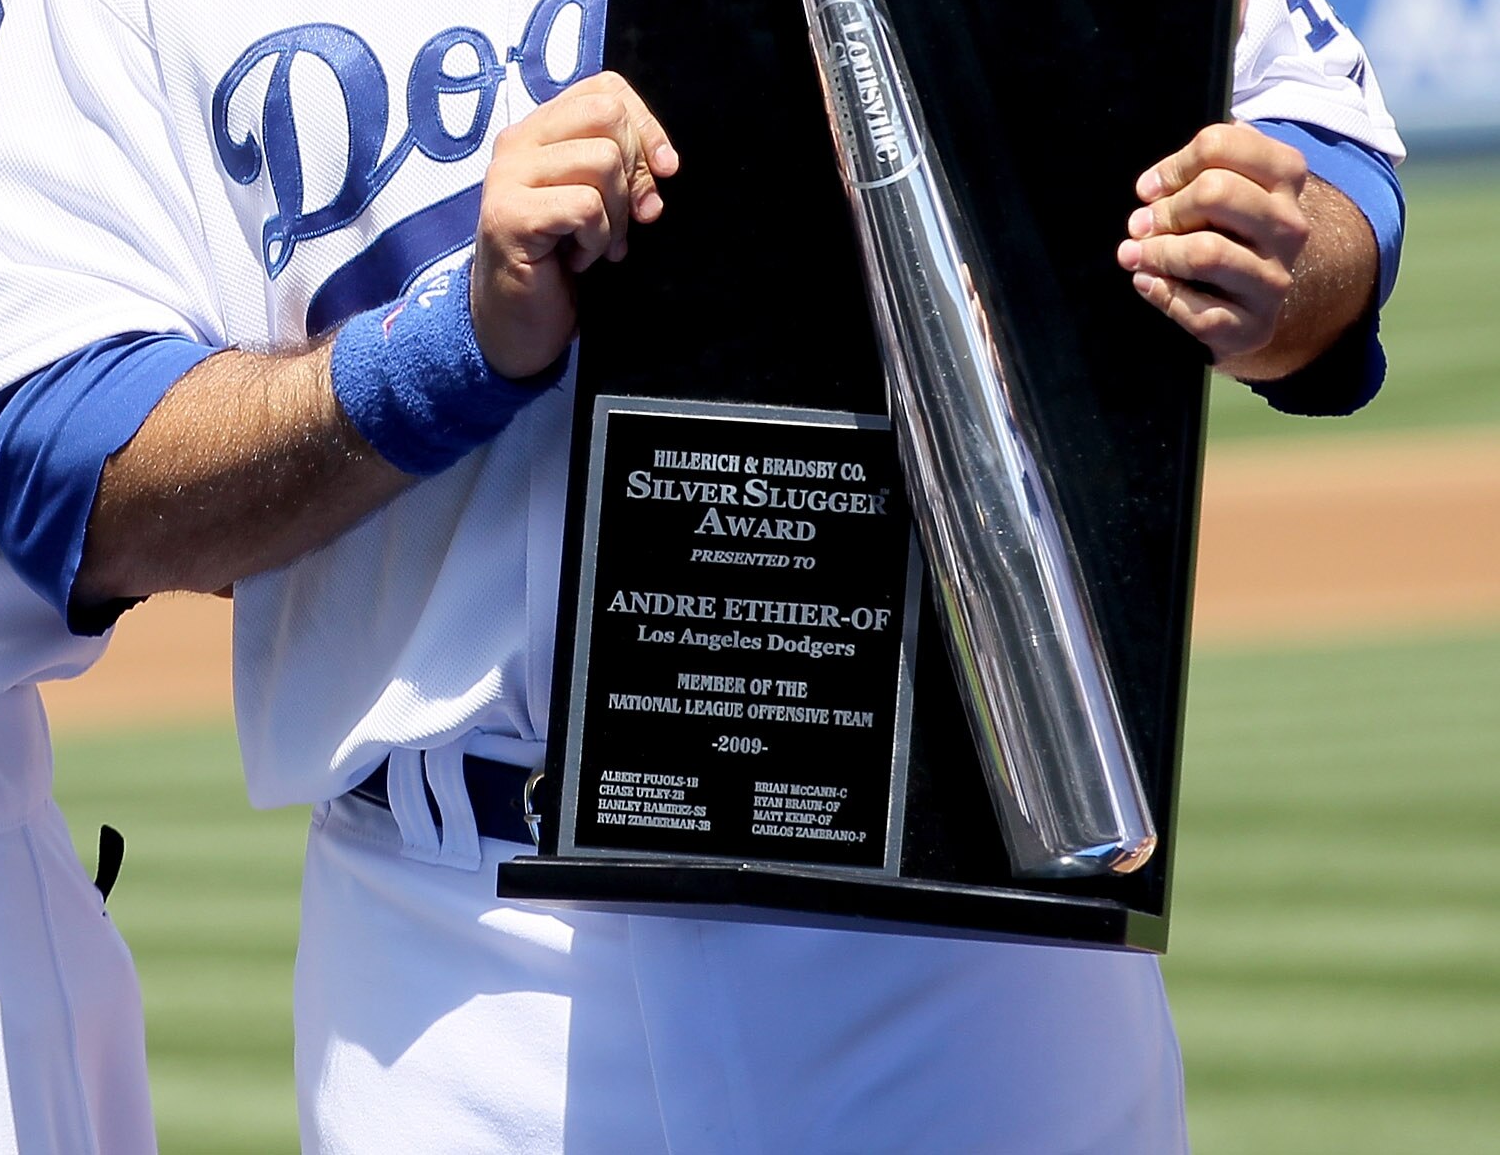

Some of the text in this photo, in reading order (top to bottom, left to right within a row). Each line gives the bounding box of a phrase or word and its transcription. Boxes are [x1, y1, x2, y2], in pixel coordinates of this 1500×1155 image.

[653, 449, 866, 482] HILLERICH & BRADSBY CO.
[626, 470, 739, 506] SILVER
[694, 507, 816, 542] AWARD
[690, 549, 816, 570] PRESENTED TO
[607, 590, 891, 631] ANDRE ETHIER-OF
[637, 625, 855, 658] Los Angeles Dodgers
[677, 672, 808, 699] MEMBER OF THE
[608, 694, 873, 728] NATIONAL LEAGUE OFFENSIVE TEAM
[712, 735, 768, 755] -2009-
[600, 770, 699, 788] ALBERT PUJOLS-1B
[754, 781, 788, 794] BRIAN
[599, 784, 685, 801] CHASE UTLEY-2B
[598, 798, 707, 817] HANLEY RAMIREZ-SS
[753, 795, 841, 812] RYAN BRAUN-OF
[597, 812, 711, 831] RYAN ZIMMERMAN-3B
[753, 809, 833, 826] MATT KEMP-OF
[752, 824, 866, 842] CARLOS ZAMBRANO-P
